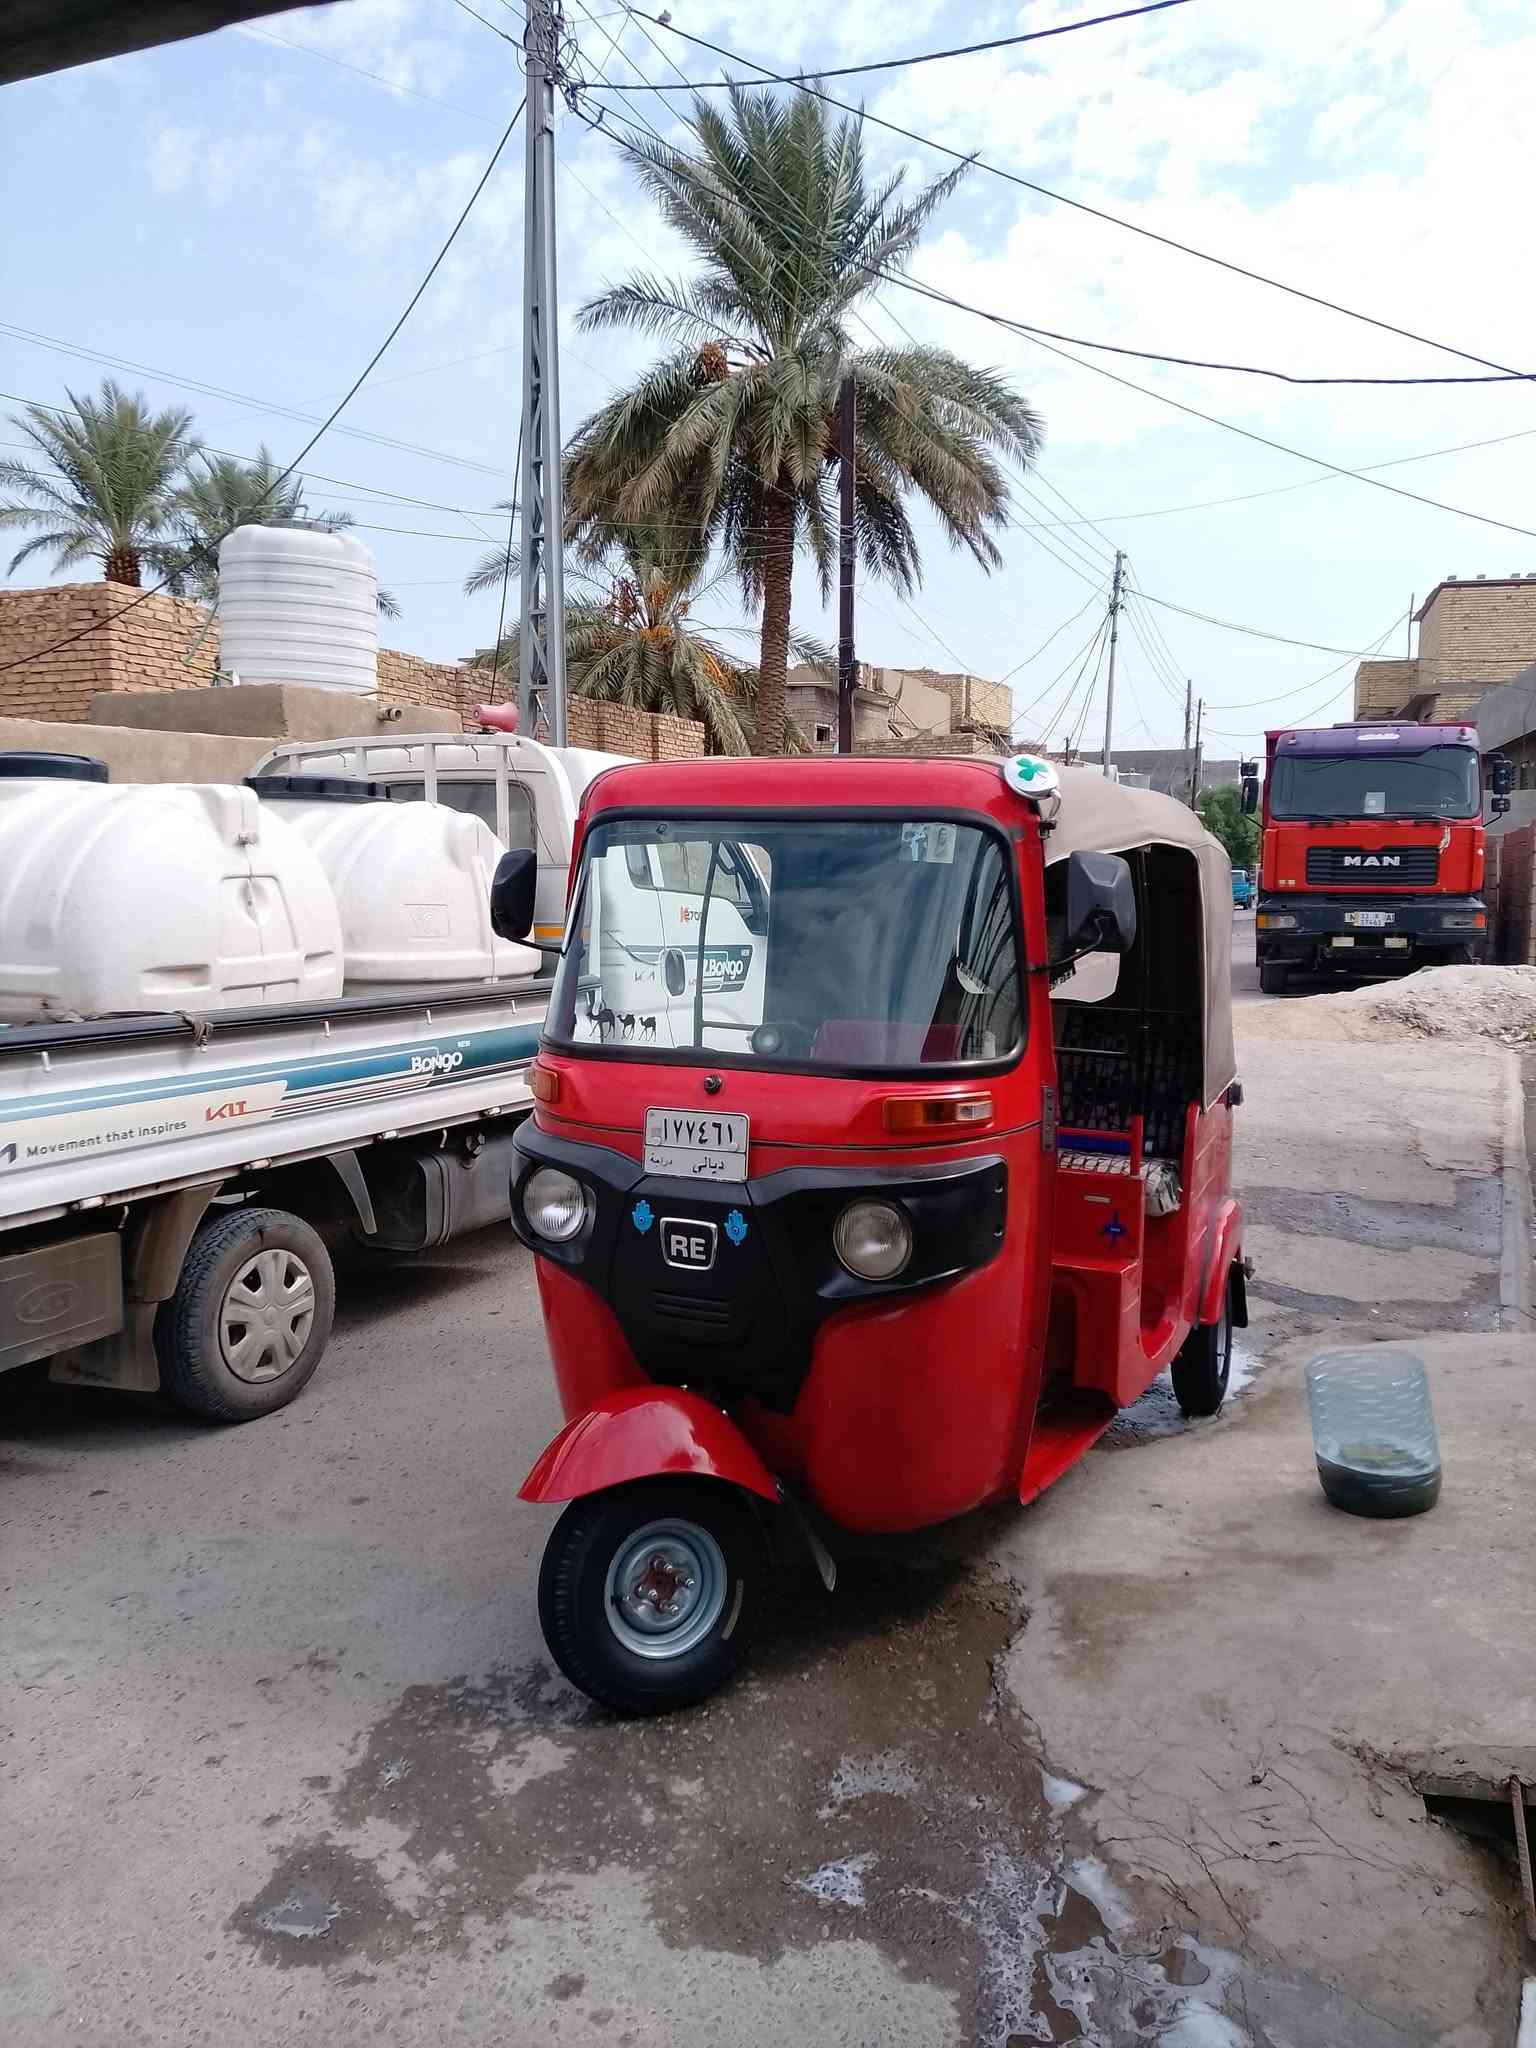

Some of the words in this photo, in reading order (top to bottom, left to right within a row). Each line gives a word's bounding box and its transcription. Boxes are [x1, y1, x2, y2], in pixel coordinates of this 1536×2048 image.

[1344, 856, 1400, 866] MAN
[26, 1136, 101, 1157] Movement
[106, 1129, 135, 1143] that
[138, 1120, 187, 1137] inspires
[664, 1118, 733, 1146] ١٧٧٤٦١
[670, 1234, 707, 1261] RE
